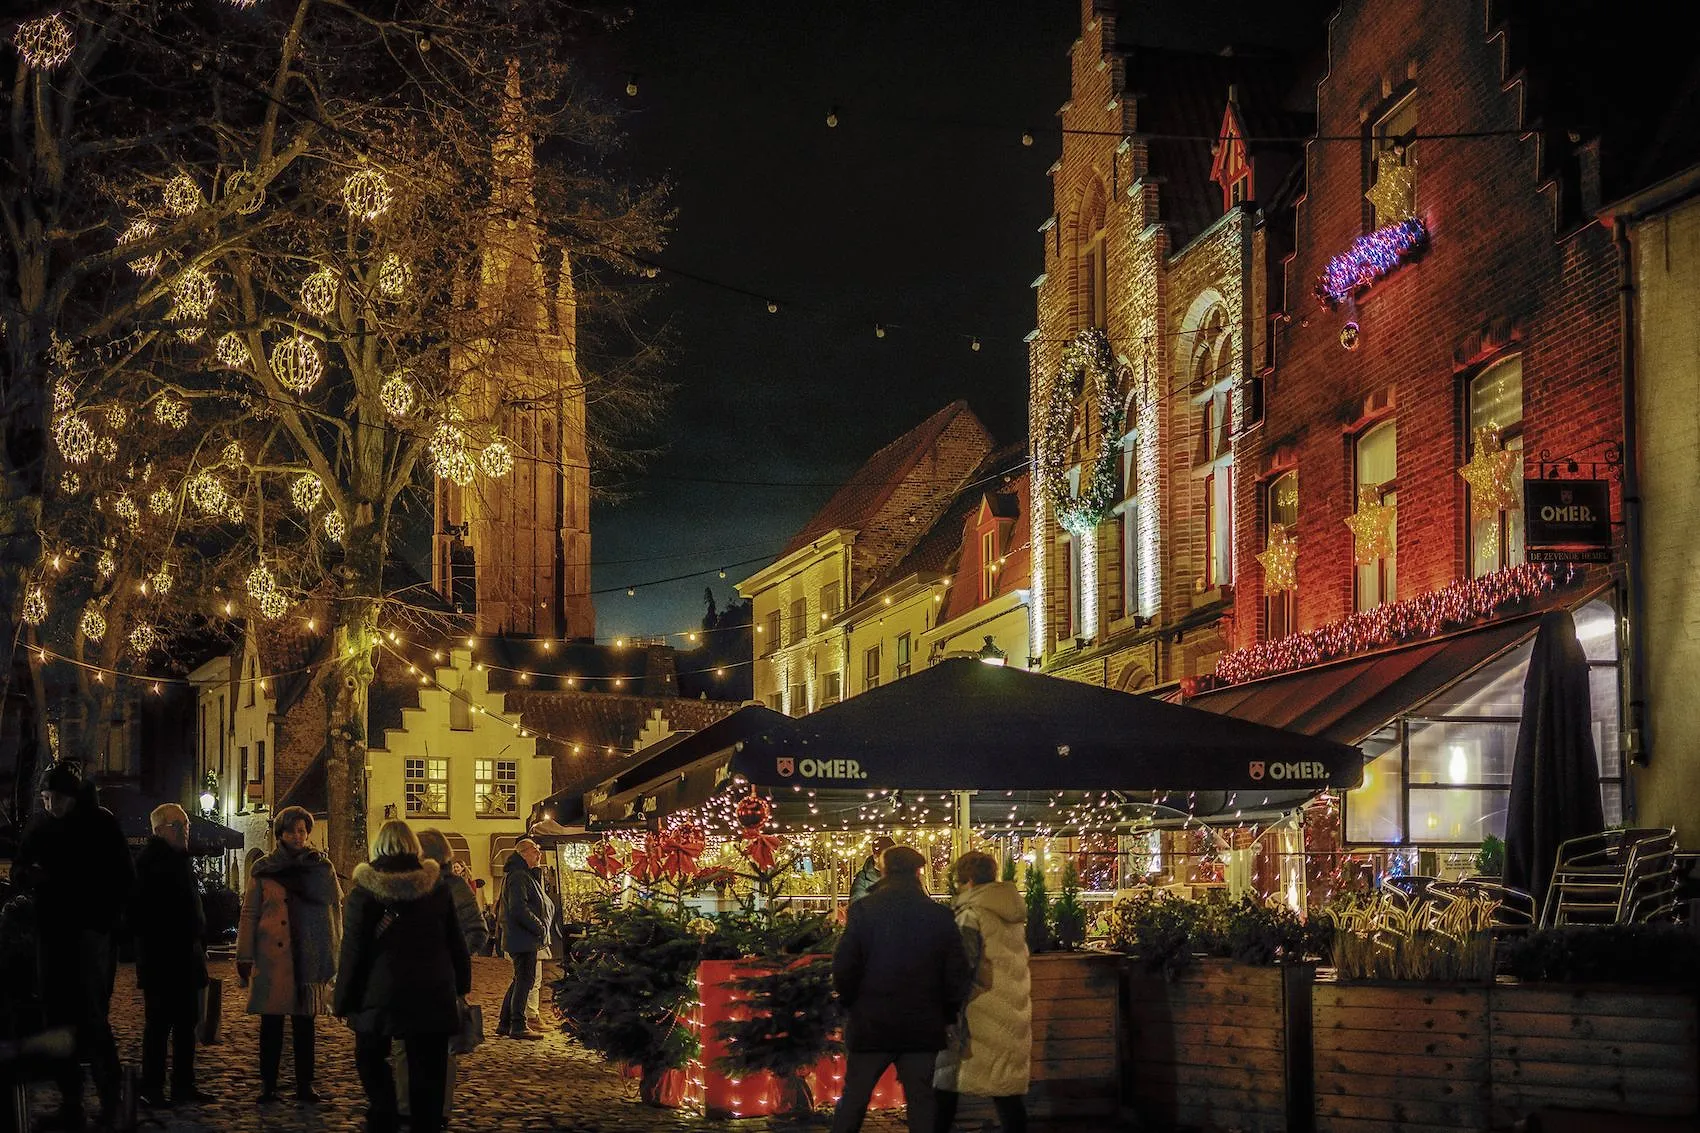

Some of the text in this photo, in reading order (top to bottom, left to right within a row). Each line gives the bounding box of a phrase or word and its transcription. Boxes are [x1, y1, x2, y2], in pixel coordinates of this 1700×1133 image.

[1541, 505, 1597, 522] OMER.
[1530, 552, 1542, 561] DE
[799, 759, 867, 779] OMER.
[1269, 762, 1330, 780] OMER.
